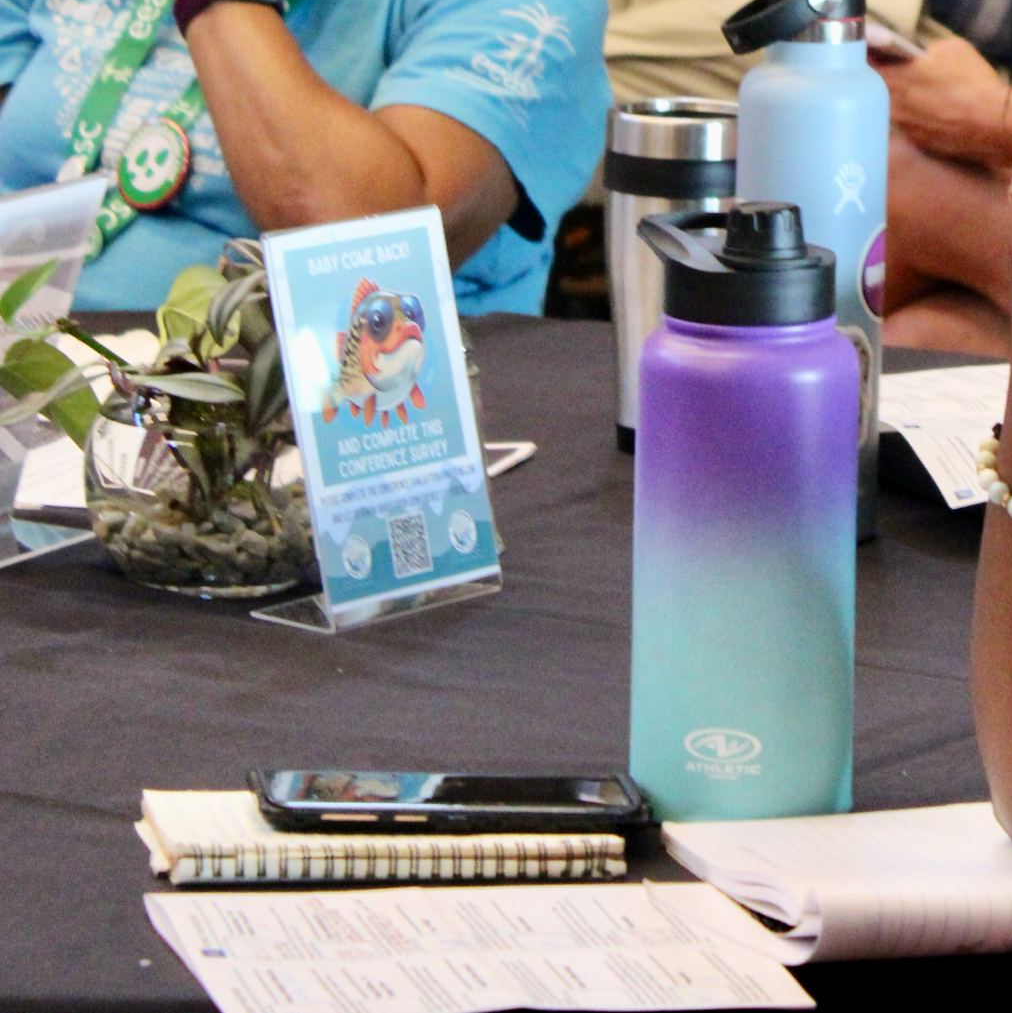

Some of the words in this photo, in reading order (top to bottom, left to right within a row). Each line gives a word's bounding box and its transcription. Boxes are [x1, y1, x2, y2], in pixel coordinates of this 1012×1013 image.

[307, 253, 339, 276] BABY
[341, 247, 376, 269] COME
[338, 436, 361, 457] AND
[362, 423, 420, 451] COMPLETE
[420, 418, 444, 438] THIS
[339, 448, 408, 478] CONFERENCE
[408, 438, 448, 463] SURVEY
